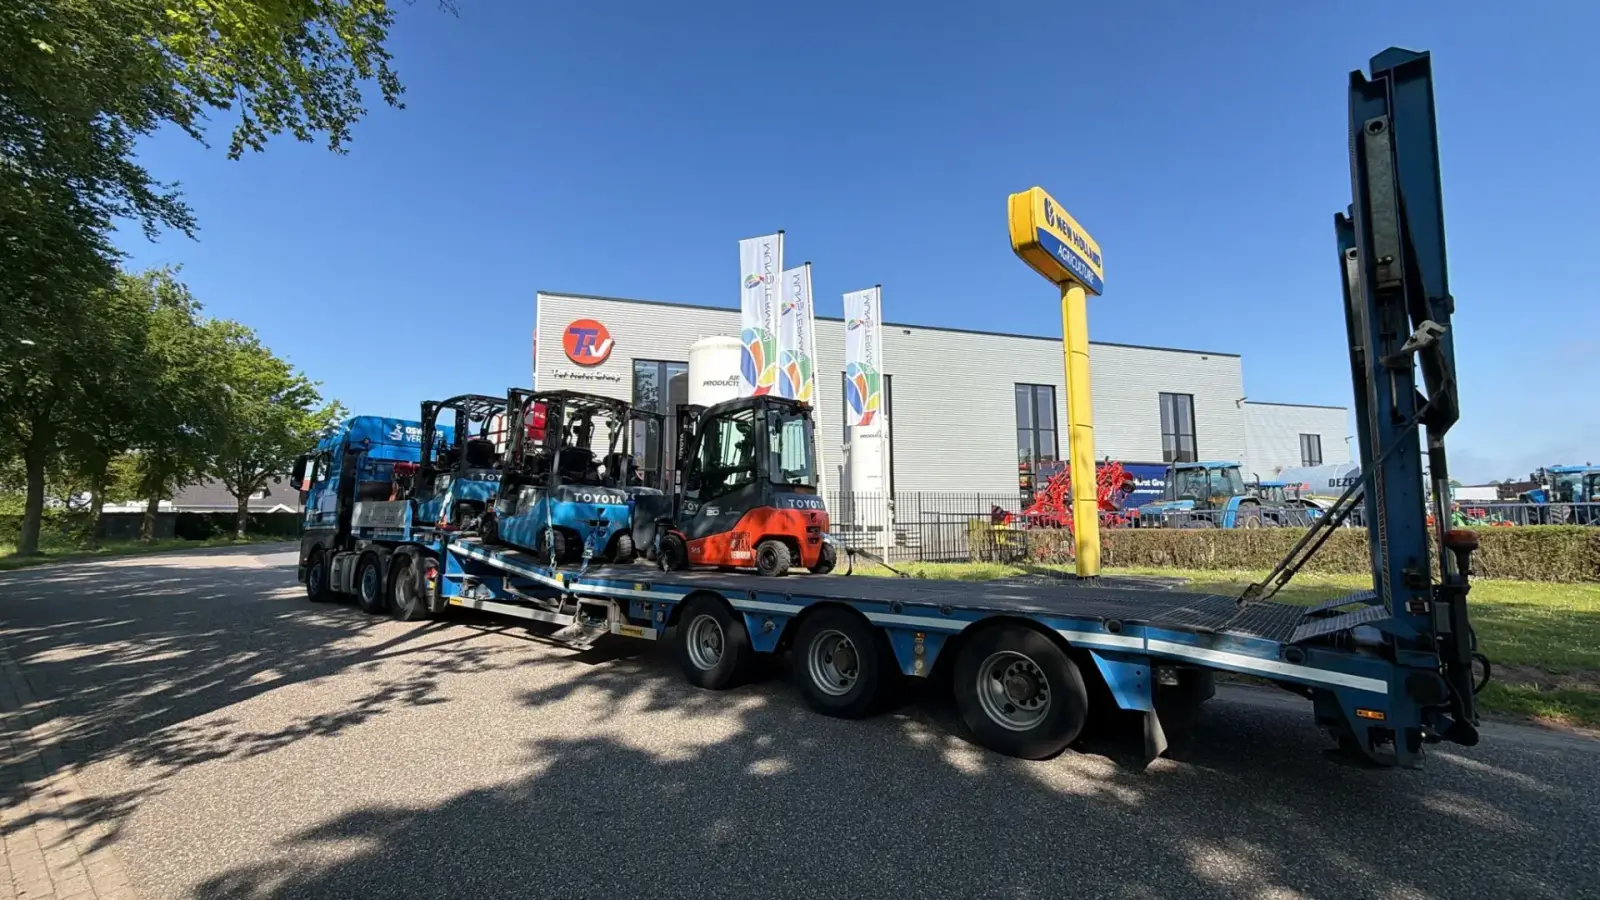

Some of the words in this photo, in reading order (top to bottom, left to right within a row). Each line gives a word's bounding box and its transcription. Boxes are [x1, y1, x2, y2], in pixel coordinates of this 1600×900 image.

[1056, 213, 1073, 241] NEW
[1073, 230, 1101, 269] HOLLAND
[1057, 244, 1094, 284] AGRICULTURE
[480, 473, 502, 481] TOY
[573, 492, 623, 504] TOYOTA
